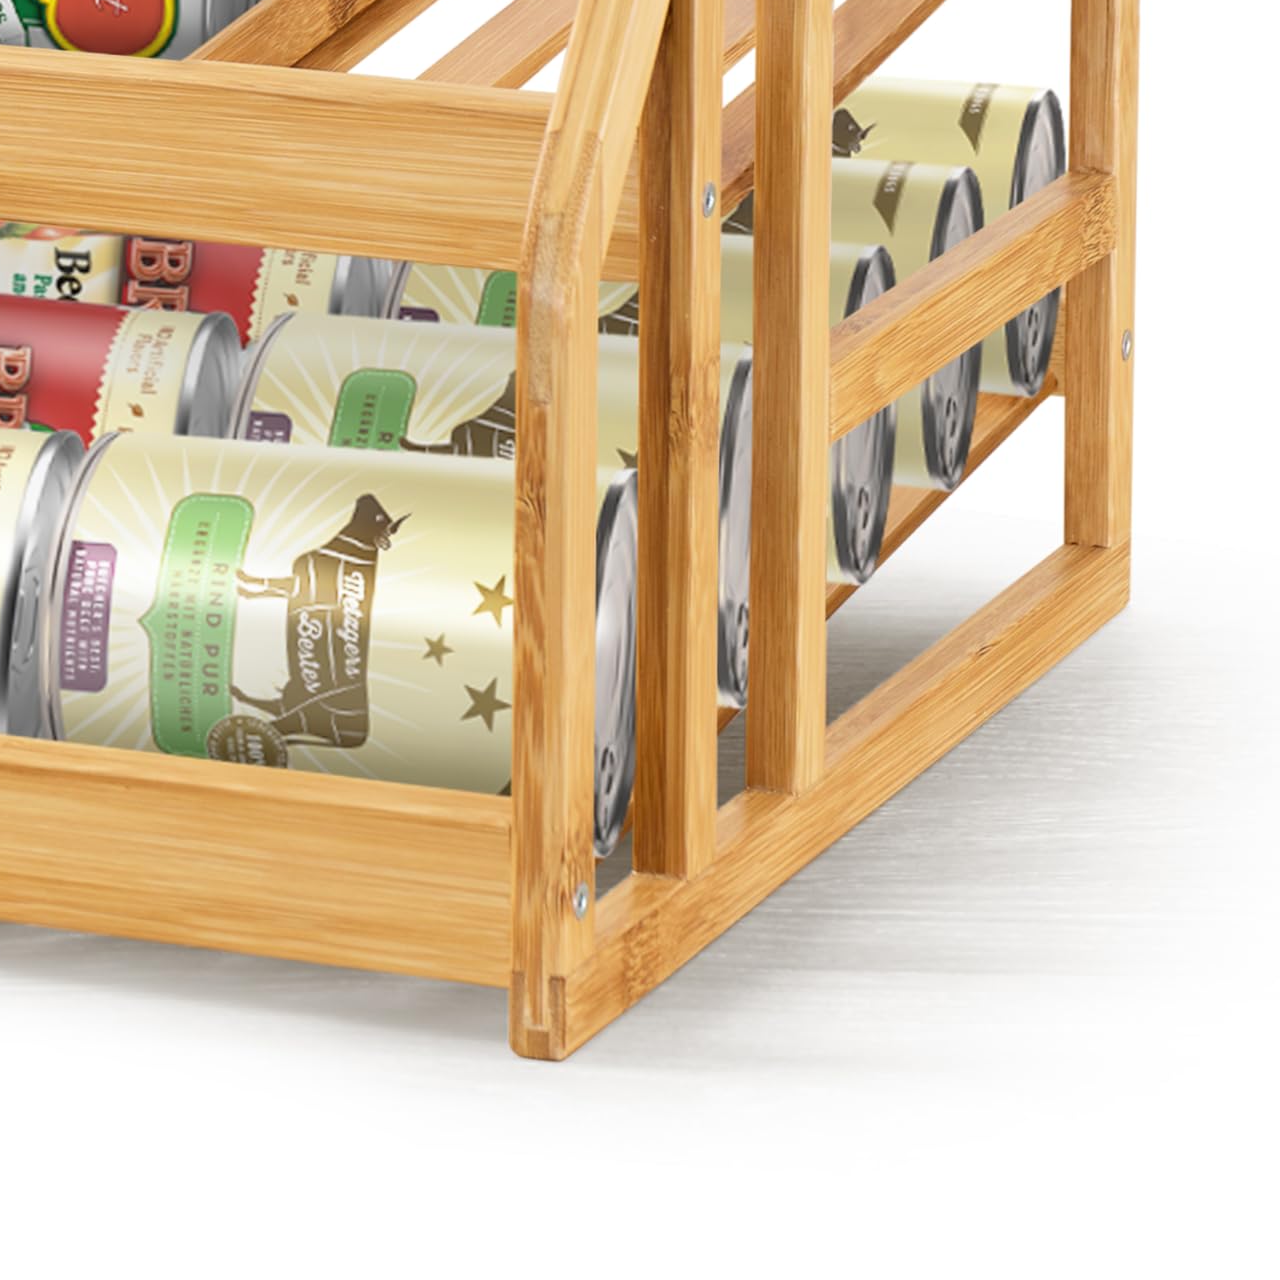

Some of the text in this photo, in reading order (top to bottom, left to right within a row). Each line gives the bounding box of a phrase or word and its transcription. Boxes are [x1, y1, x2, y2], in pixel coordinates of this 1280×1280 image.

[54, 247, 92, 302] Be
[201, 561, 229, 698] RIND PUR
